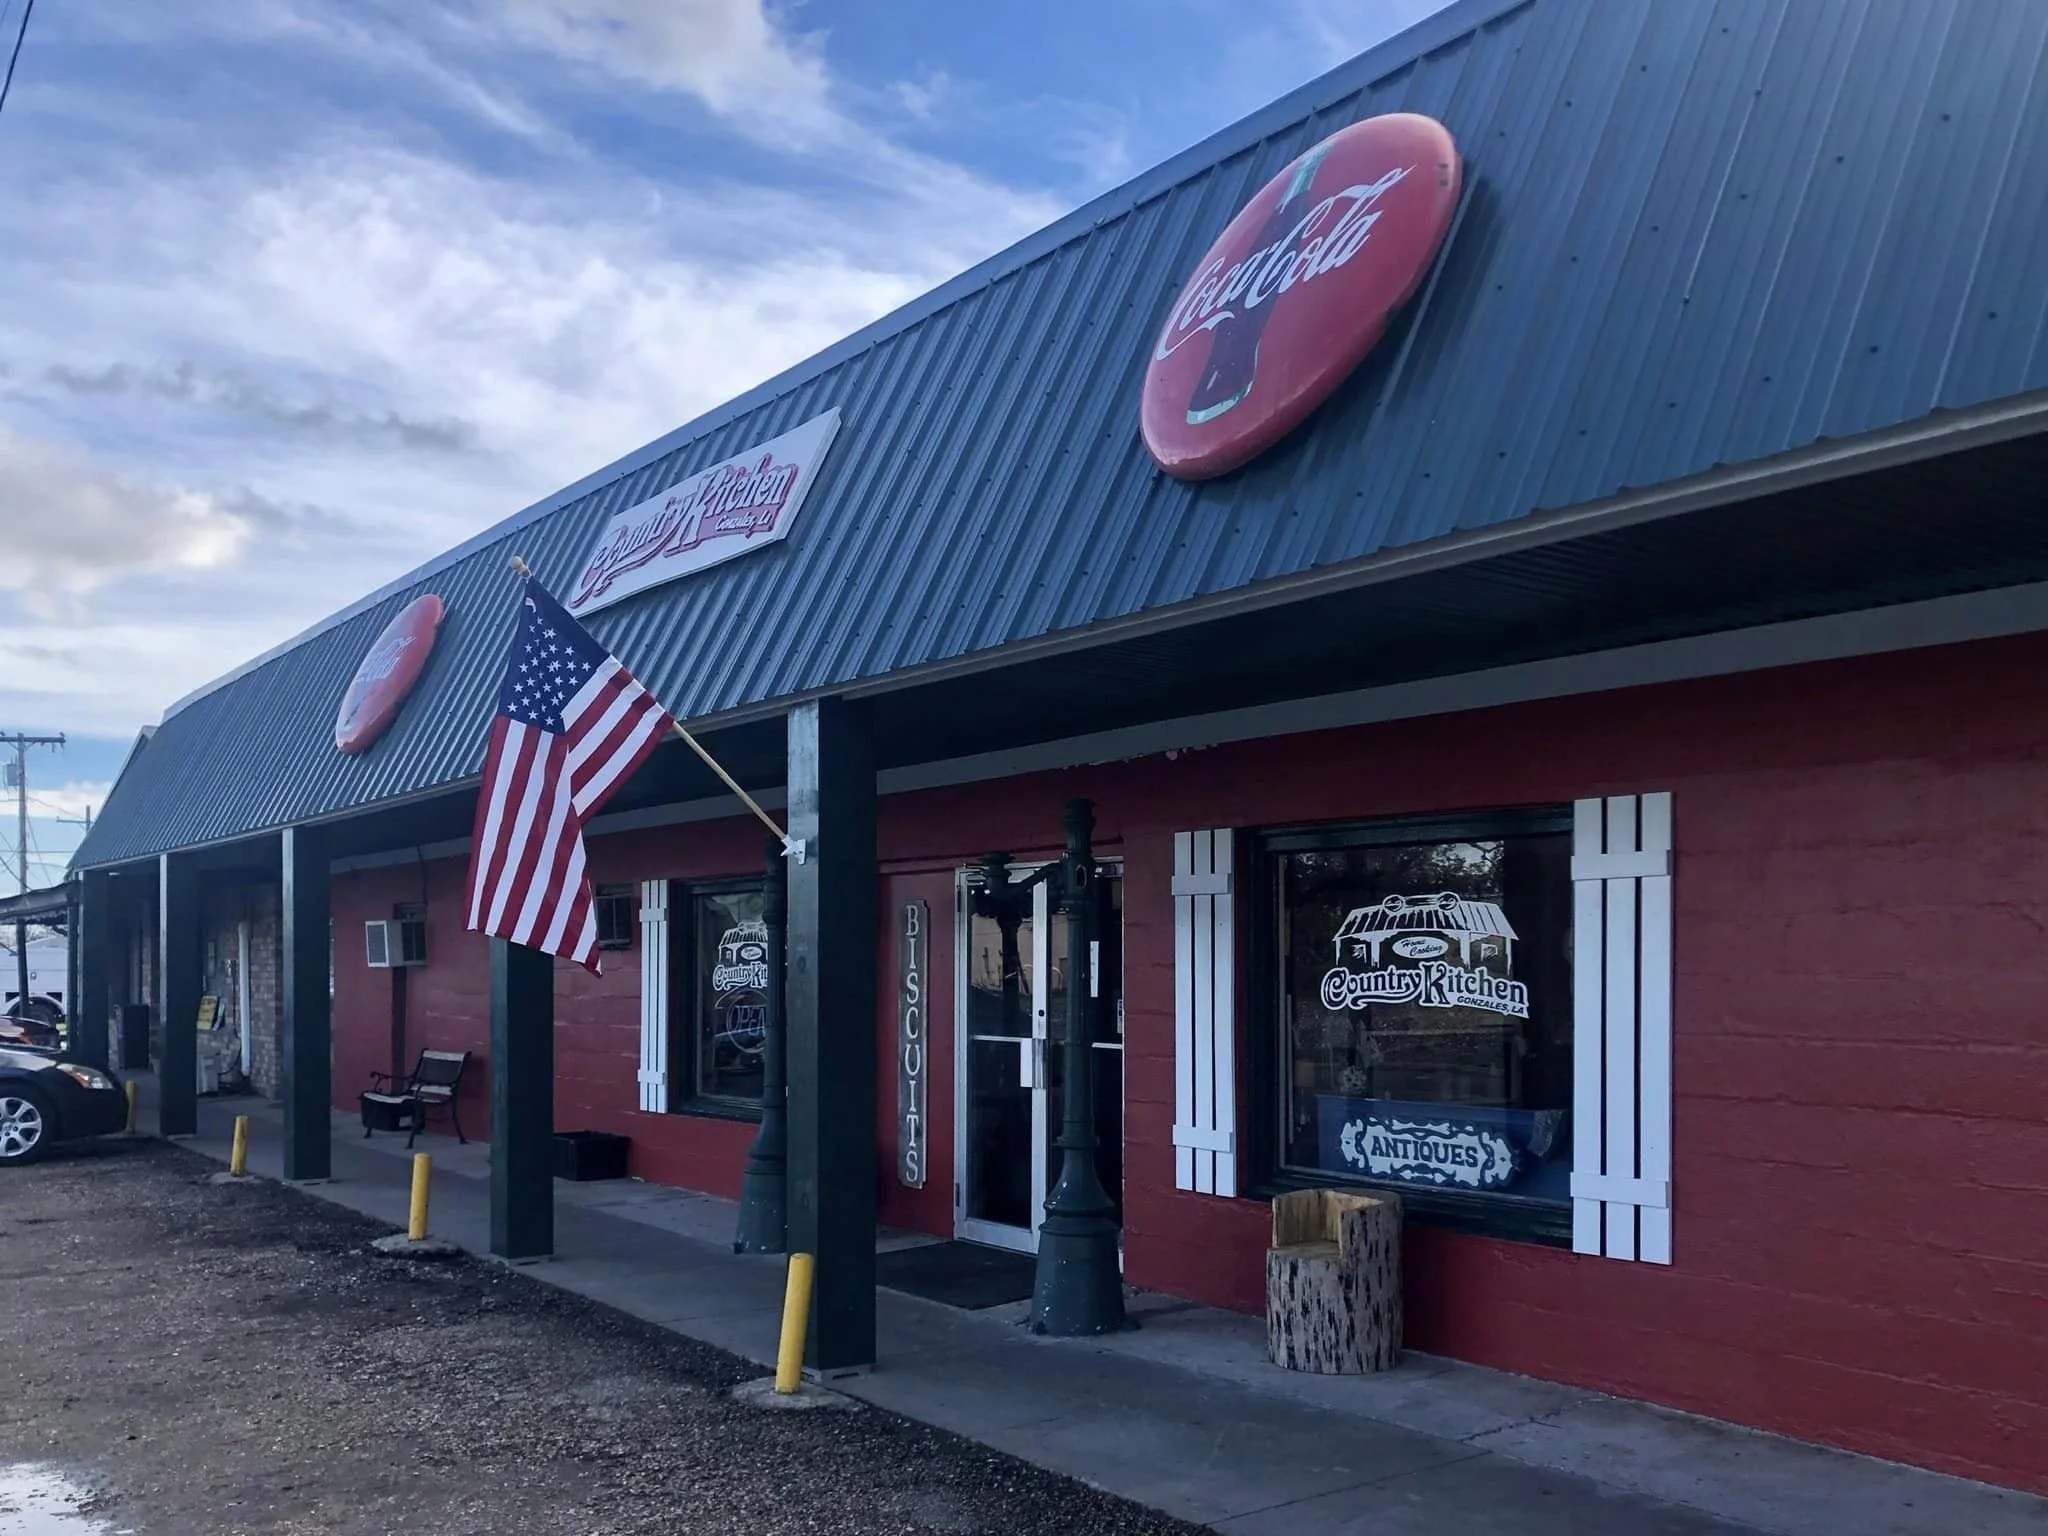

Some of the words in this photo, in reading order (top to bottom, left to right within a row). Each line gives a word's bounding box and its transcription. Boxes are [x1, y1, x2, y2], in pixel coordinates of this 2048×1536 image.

[662, 453, 797, 558] Kitchen
[713, 964, 754, 990] Country
[1322, 964, 1423, 1009] Country
[1420, 963, 1529, 1007] Kitchen
[1457, 995, 1510, 1013] GONZALES,
[1511, 1005, 1525, 1014] LA
[904, 904, 921, 1182] BISCUITS
[1370, 1135, 1478, 1168] ANTIQUES
